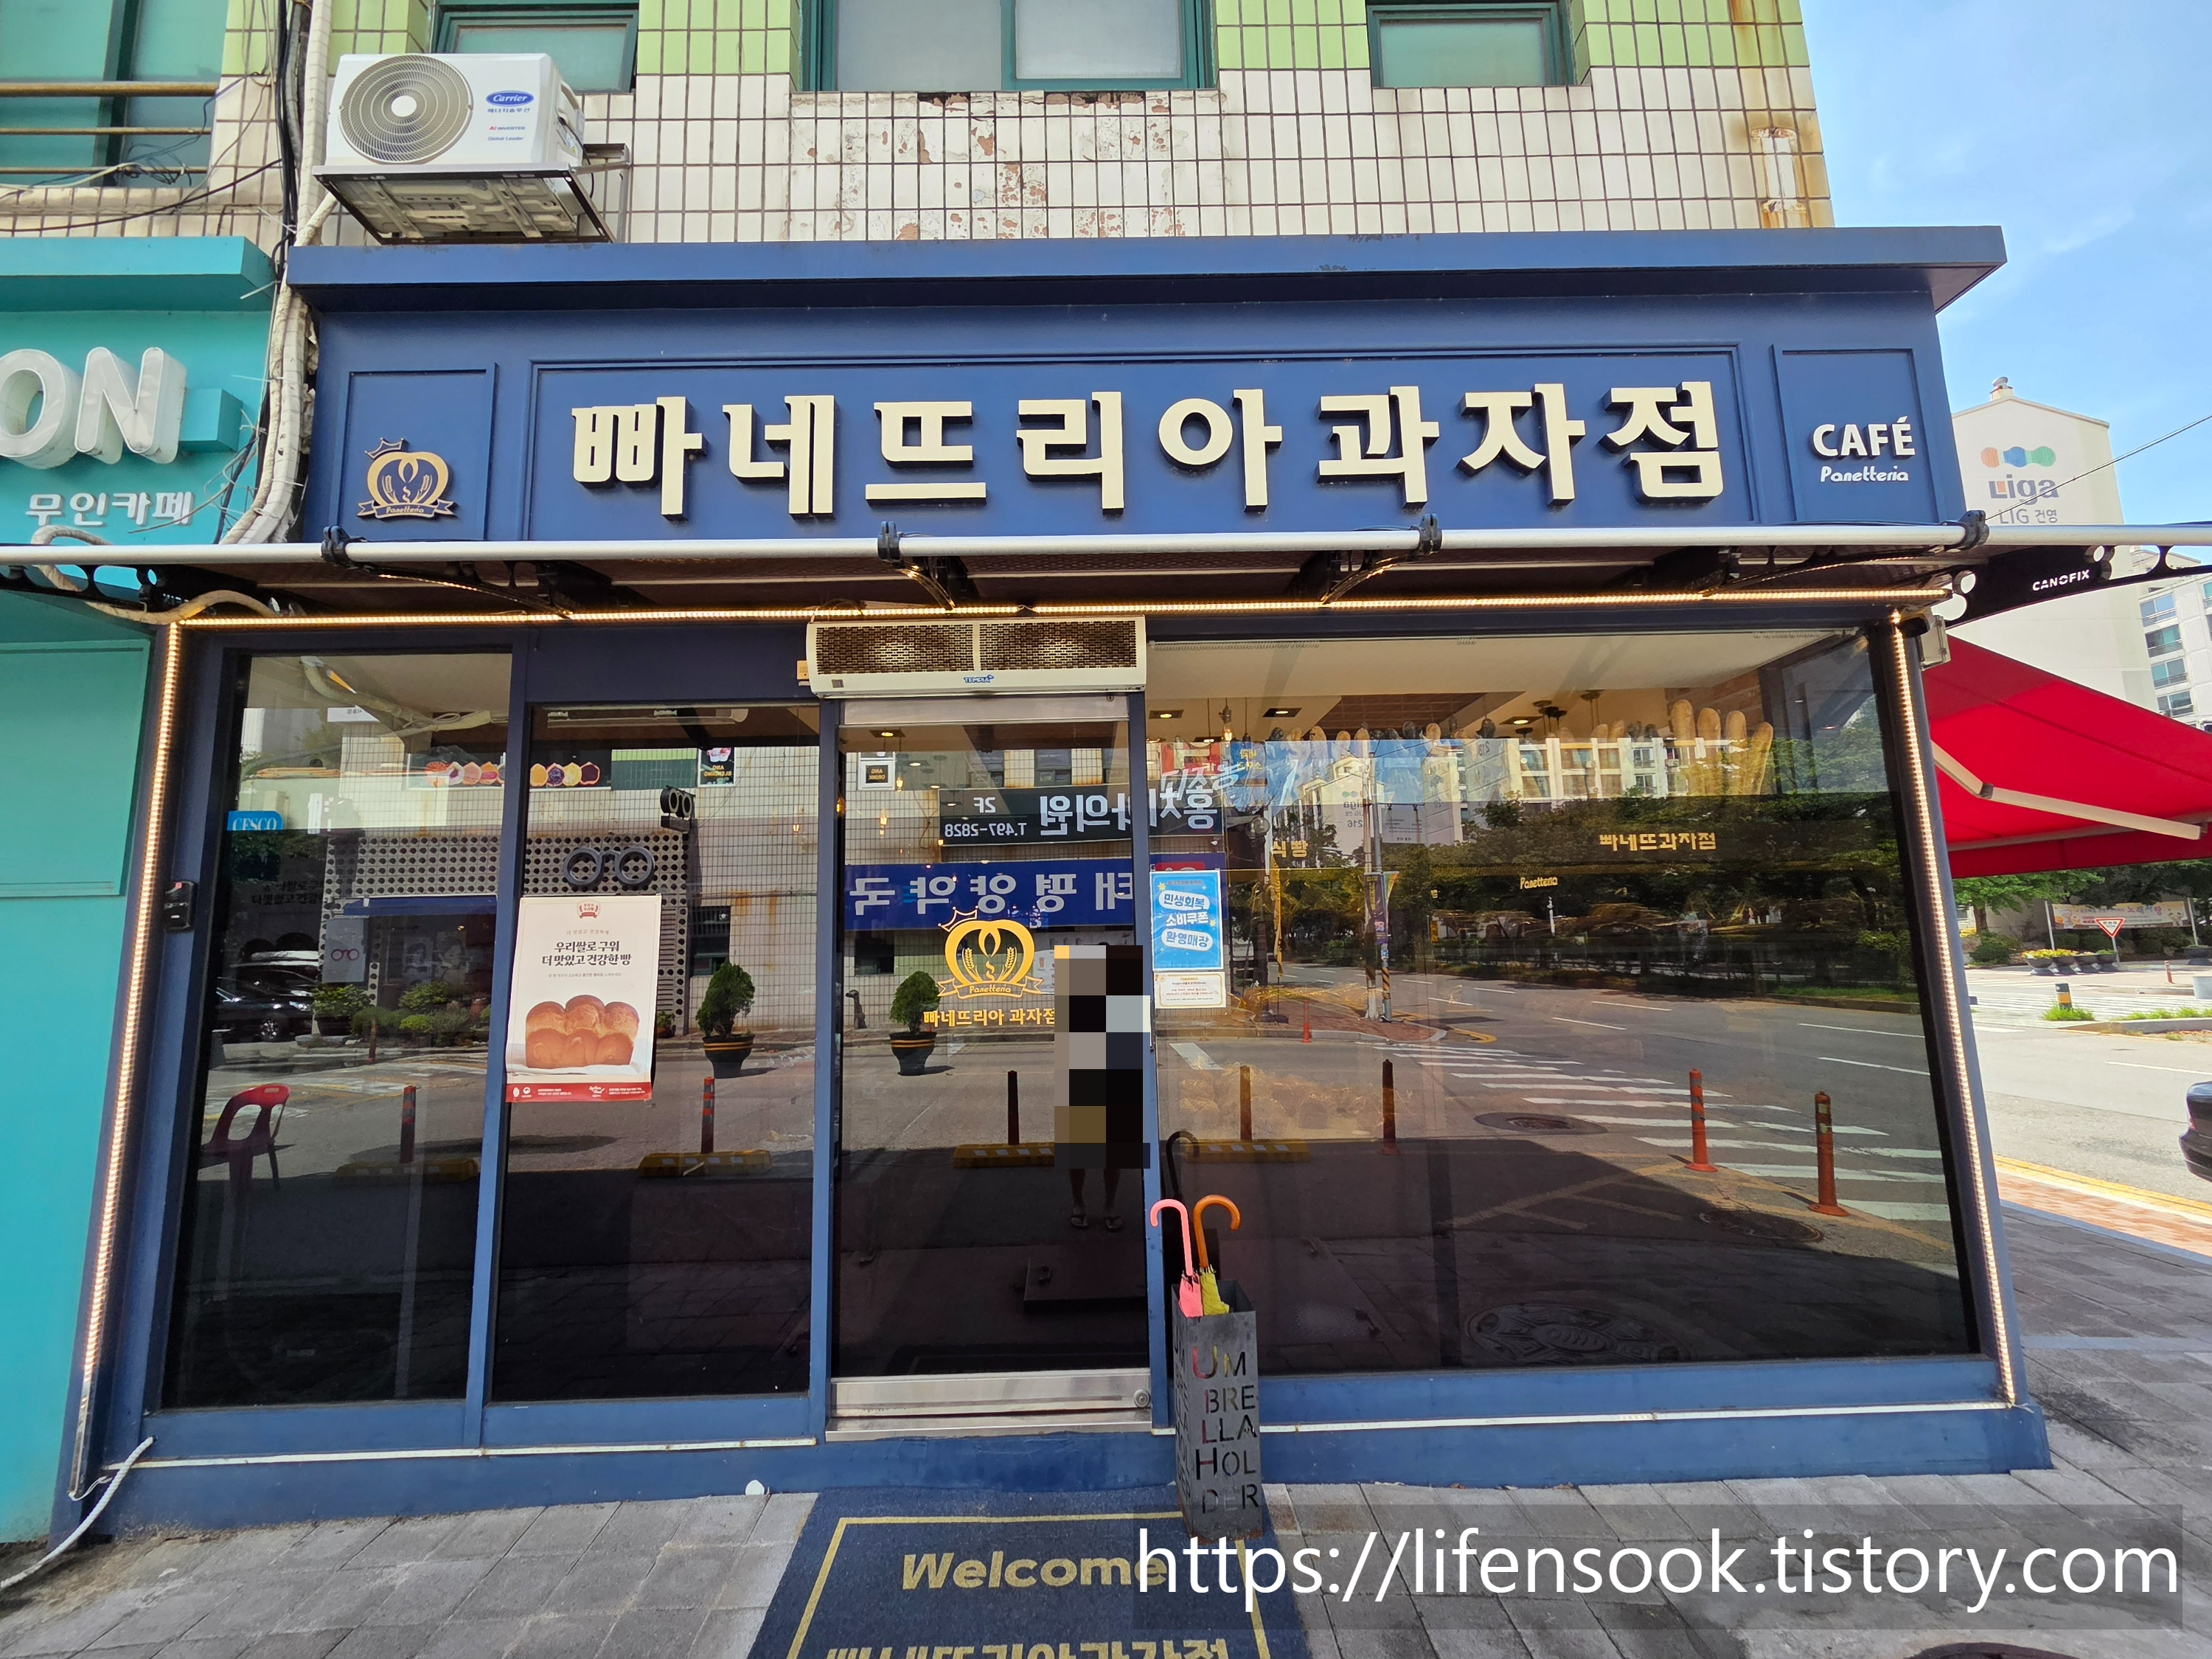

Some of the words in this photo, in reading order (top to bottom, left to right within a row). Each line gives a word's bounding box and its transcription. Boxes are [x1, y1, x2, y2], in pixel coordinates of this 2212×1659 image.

[493, 94, 528, 102] Carrier
[0, 347, 186, 467] ON
[1810, 415, 1916, 459] CAFÉ
[571, 380, 1725, 521] 빠네뜨리아과자점
[1820, 465, 1909, 482] Panetteria
[1989, 474, 2059, 505] Liga
[25, 490, 194, 526] 무인카페
[386, 506, 425, 514] Panetteria
[1998, 509, 2030, 524] LIG
[2034, 509, 2058, 524] 건영
[2032, 568, 2090, 591] CANOFIX
[1599, 832, 1717, 852] 빠네뜨과자점
[1520, 876, 1558, 890] Panetteria
[1164, 893, 1205, 909] 민생회복
[1165, 911, 1209, 927] 소비쿠폰
[554, 941, 597, 953] 우리쌀로
[597, 941, 619, 952] 구워
[1166, 931, 1209, 947] 환영매장
[542, 955, 552, 966] 더
[554, 954, 585, 967] 맛있고
[587, 953, 619, 966] 건강한
[620, 953, 632, 966] 빵
[969, 984, 1012, 994] Panetteria
[923, 1009, 1005, 1027] 빠네뜨리아
[1192, 1344, 1246, 1379] UM
[1205, 1385, 1256, 1413] BRE
[1202, 1414, 1257, 1444] LLA
[1195, 1447, 1257, 1481] HOL
[1202, 1484, 1259, 1514] DER
[902, 1550, 1170, 1590] Welcome
